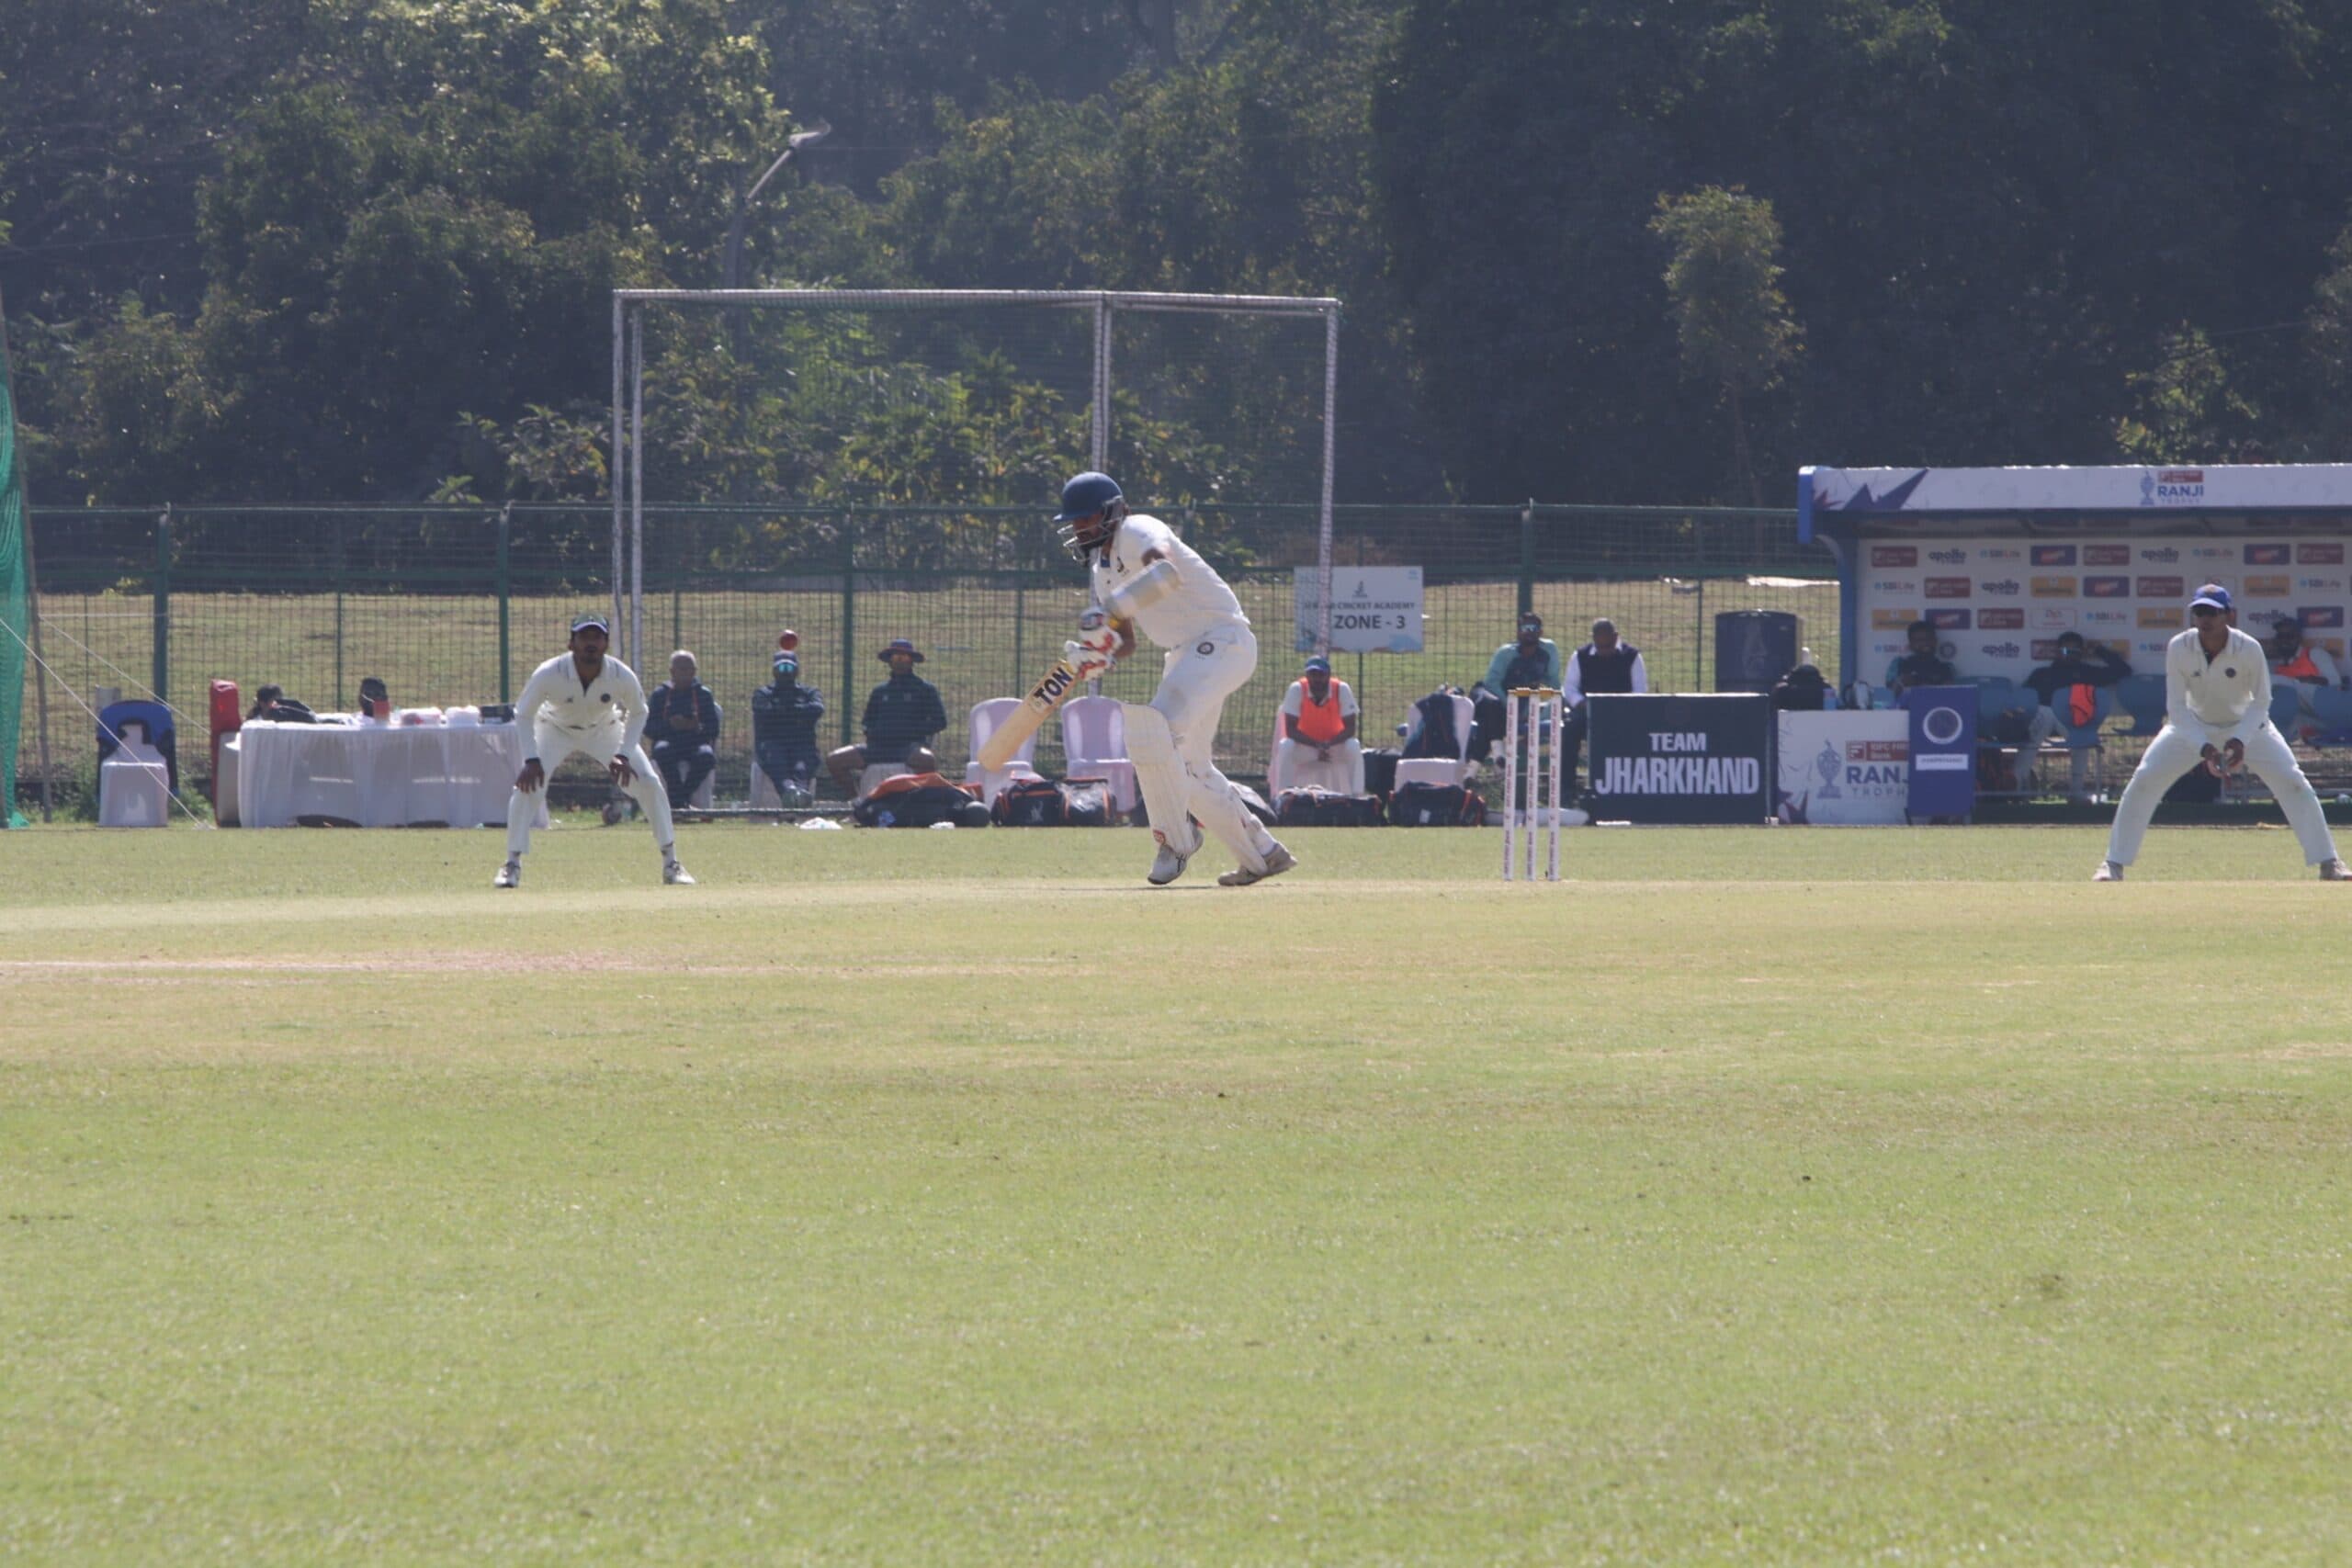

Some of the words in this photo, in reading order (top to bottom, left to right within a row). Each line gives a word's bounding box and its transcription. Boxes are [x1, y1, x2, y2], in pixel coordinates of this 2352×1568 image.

[2157, 485, 2204, 497] RANJI
[1928, 548, 1967, 562] apollo
[2142, 547, 2179, 561] apollo
[1982, 579, 2020, 593] apollo
[1334, 615, 1382, 629] ZONE
[1396, 615, 1406, 629] 3
[2248, 610, 2287, 624] apollo
[1982, 642, 2020, 656] apollo
[1034, 667, 1073, 705] TON
[1649, 733, 1707, 751] TEAM
[1595, 757, 1759, 795] JHARKHAND
[1847, 766, 1908, 784] RAN
[1852, 787, 1905, 796] TROPH
